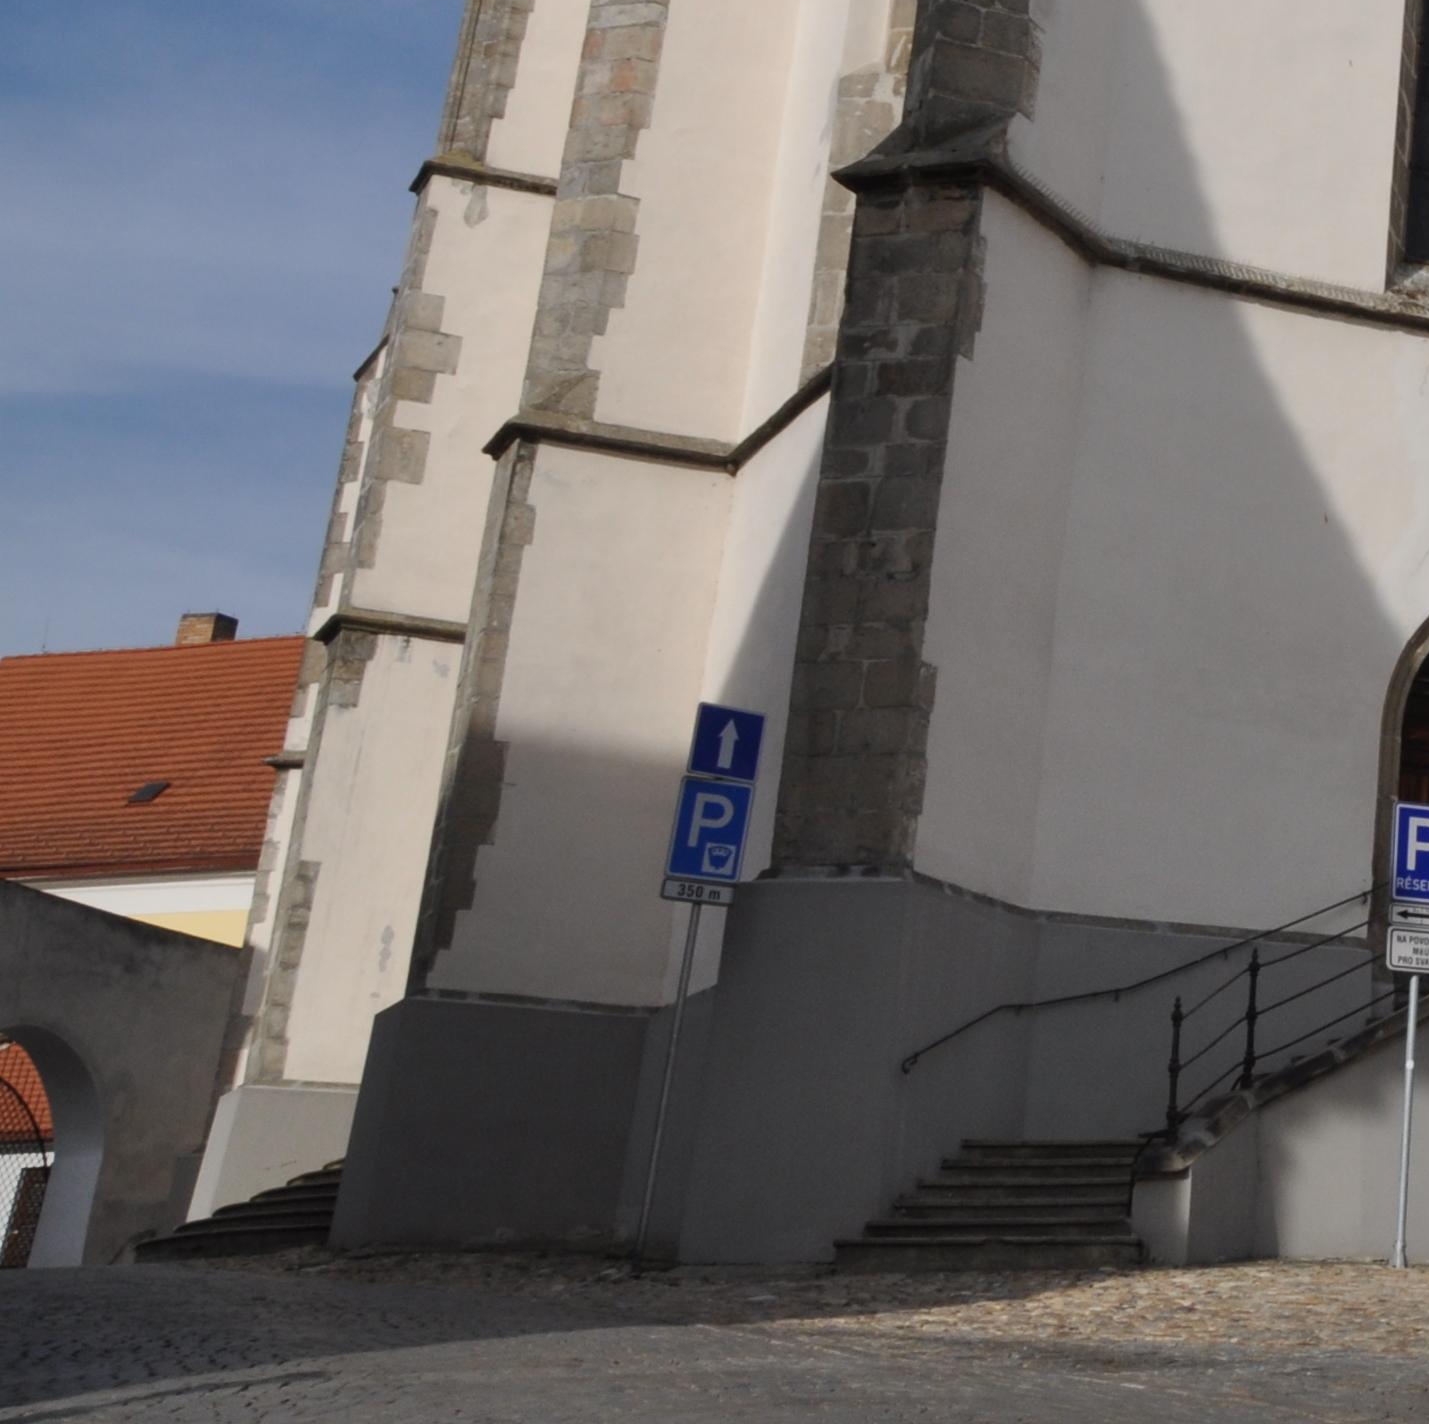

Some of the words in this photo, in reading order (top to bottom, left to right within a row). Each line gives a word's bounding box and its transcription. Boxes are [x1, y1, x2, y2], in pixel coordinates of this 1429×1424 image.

[687, 792, 734, 847] P
[677, 883, 704, 898] 350
[708, 889, 721, 900] m
[1397, 956, 1413, 965] PRO
